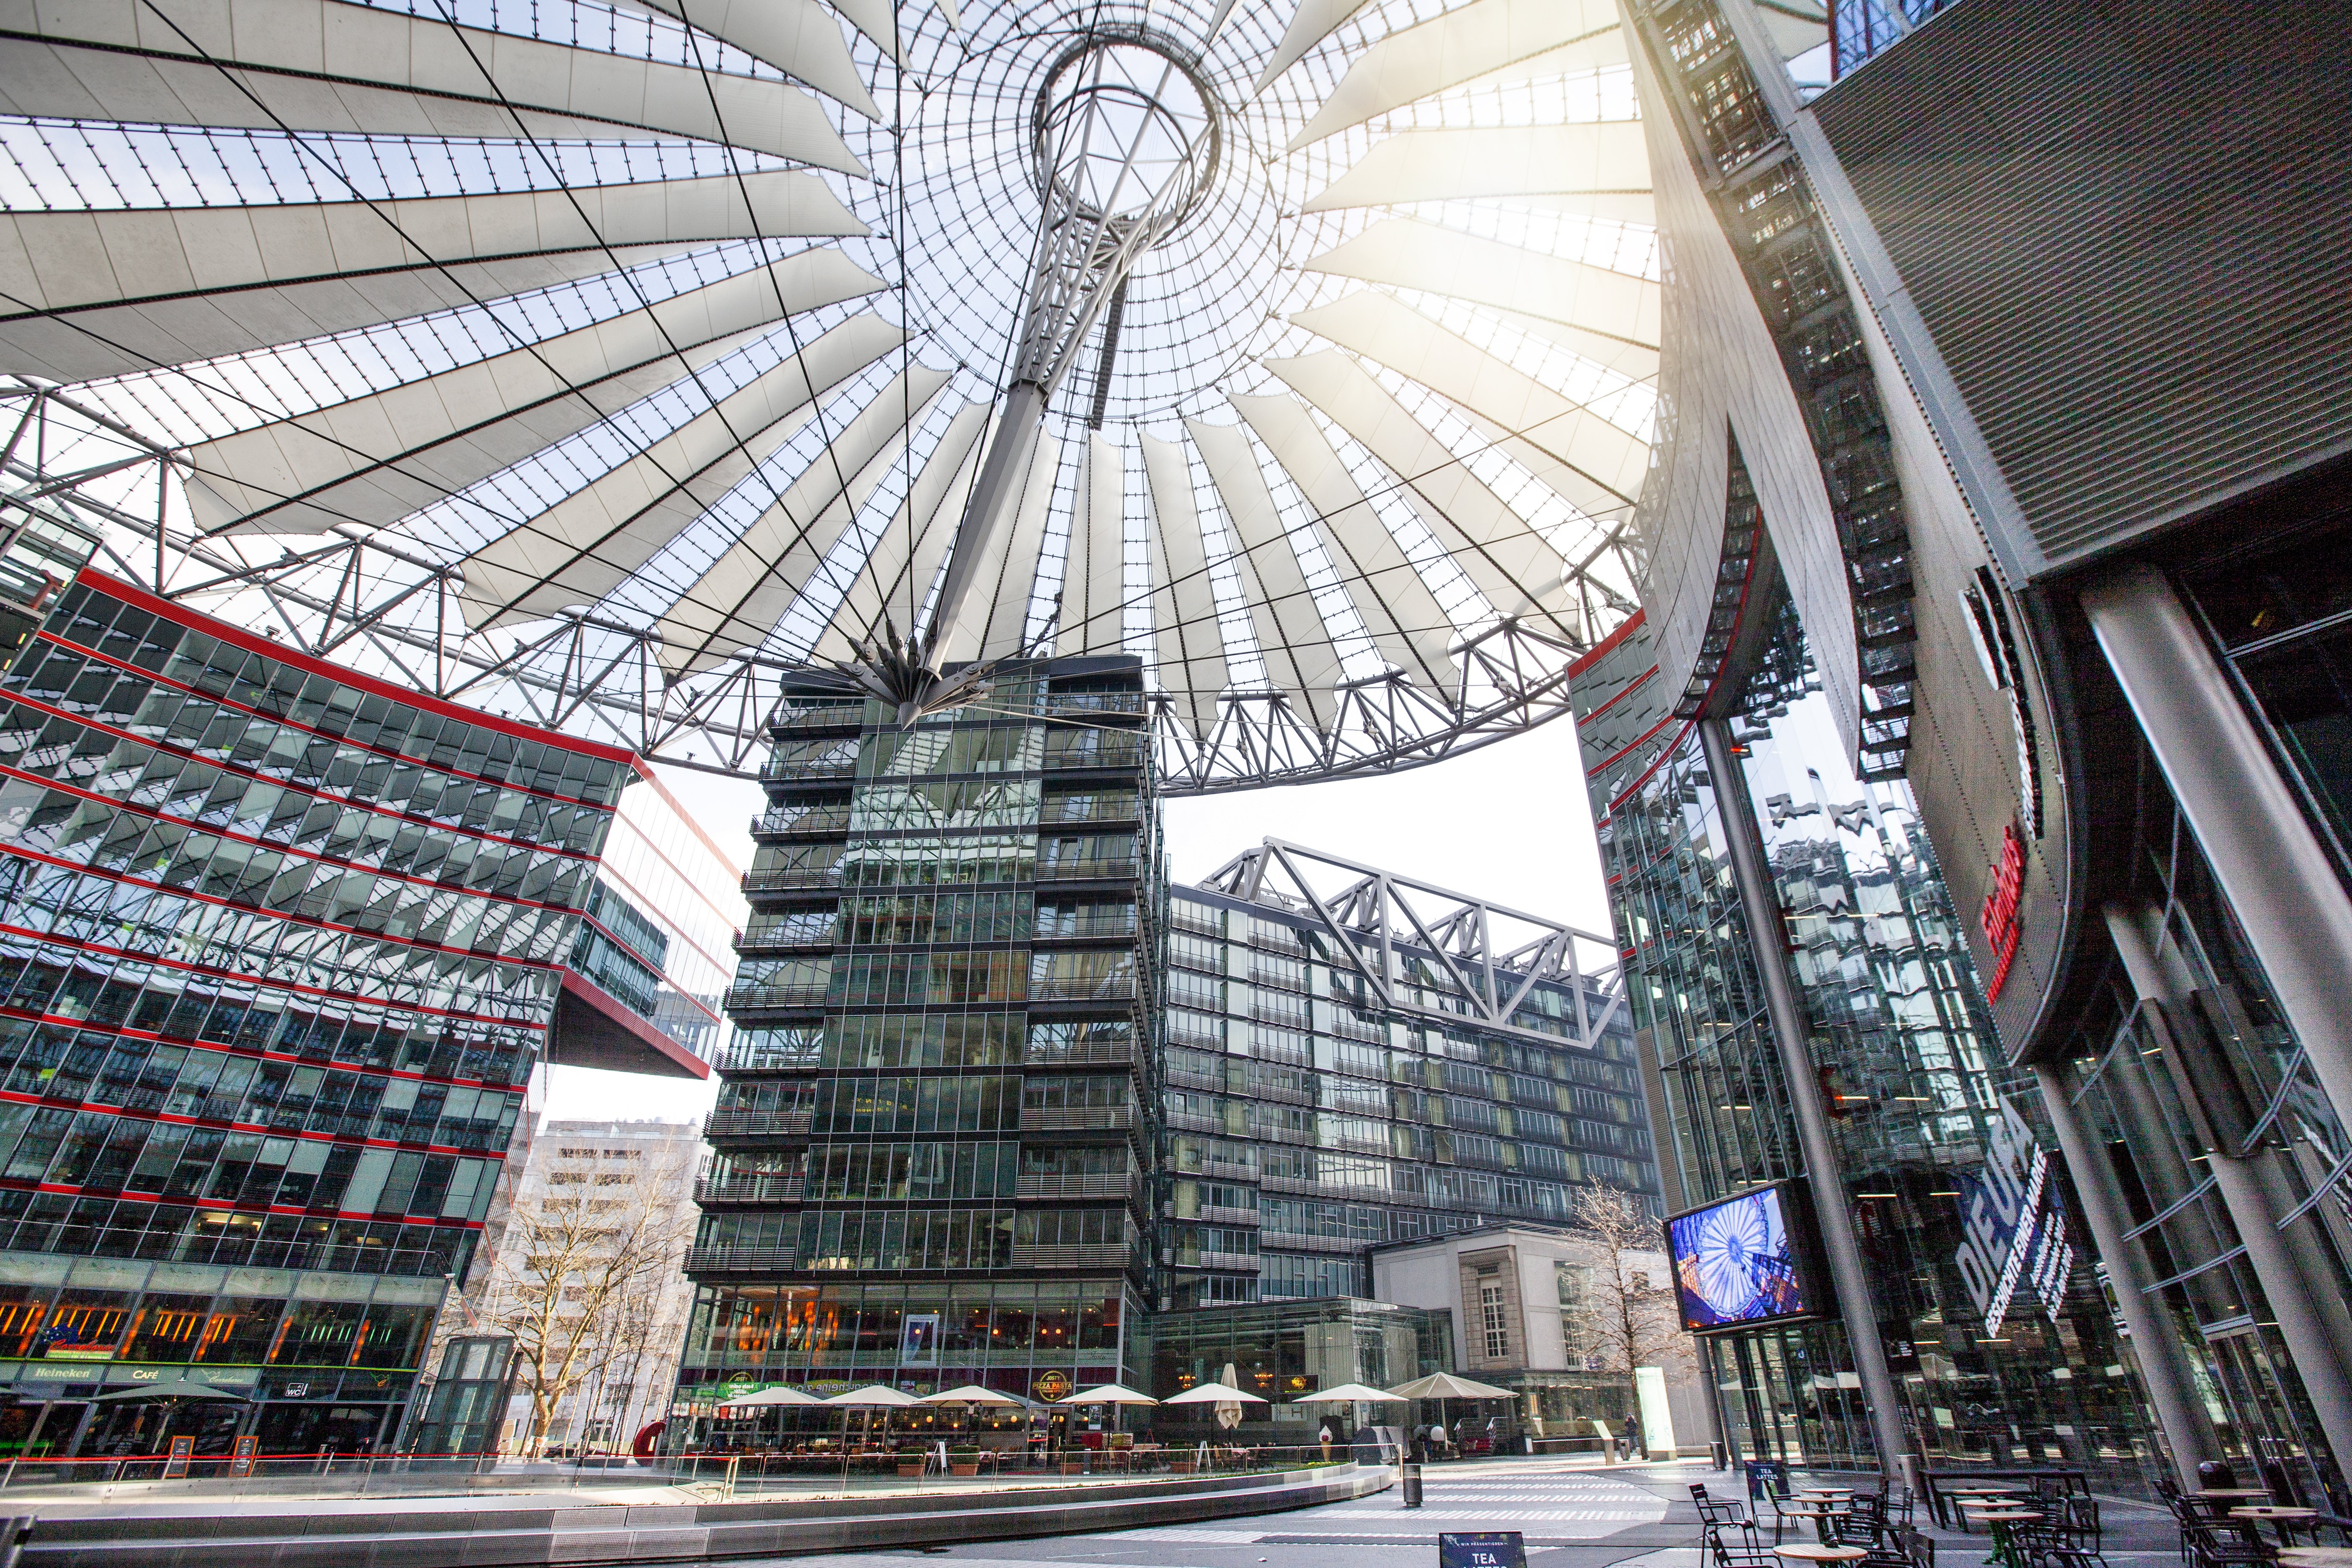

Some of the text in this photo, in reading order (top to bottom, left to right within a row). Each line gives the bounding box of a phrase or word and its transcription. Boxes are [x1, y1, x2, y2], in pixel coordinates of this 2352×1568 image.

[1955, 1092, 2035, 1316] DIE UFA
[1985, 1142, 2047, 1338] GESCHICHTE EINER MARKE
[35, 1368, 90, 1378] Heineken
[1472, 1553, 1497, 1564] TEA
